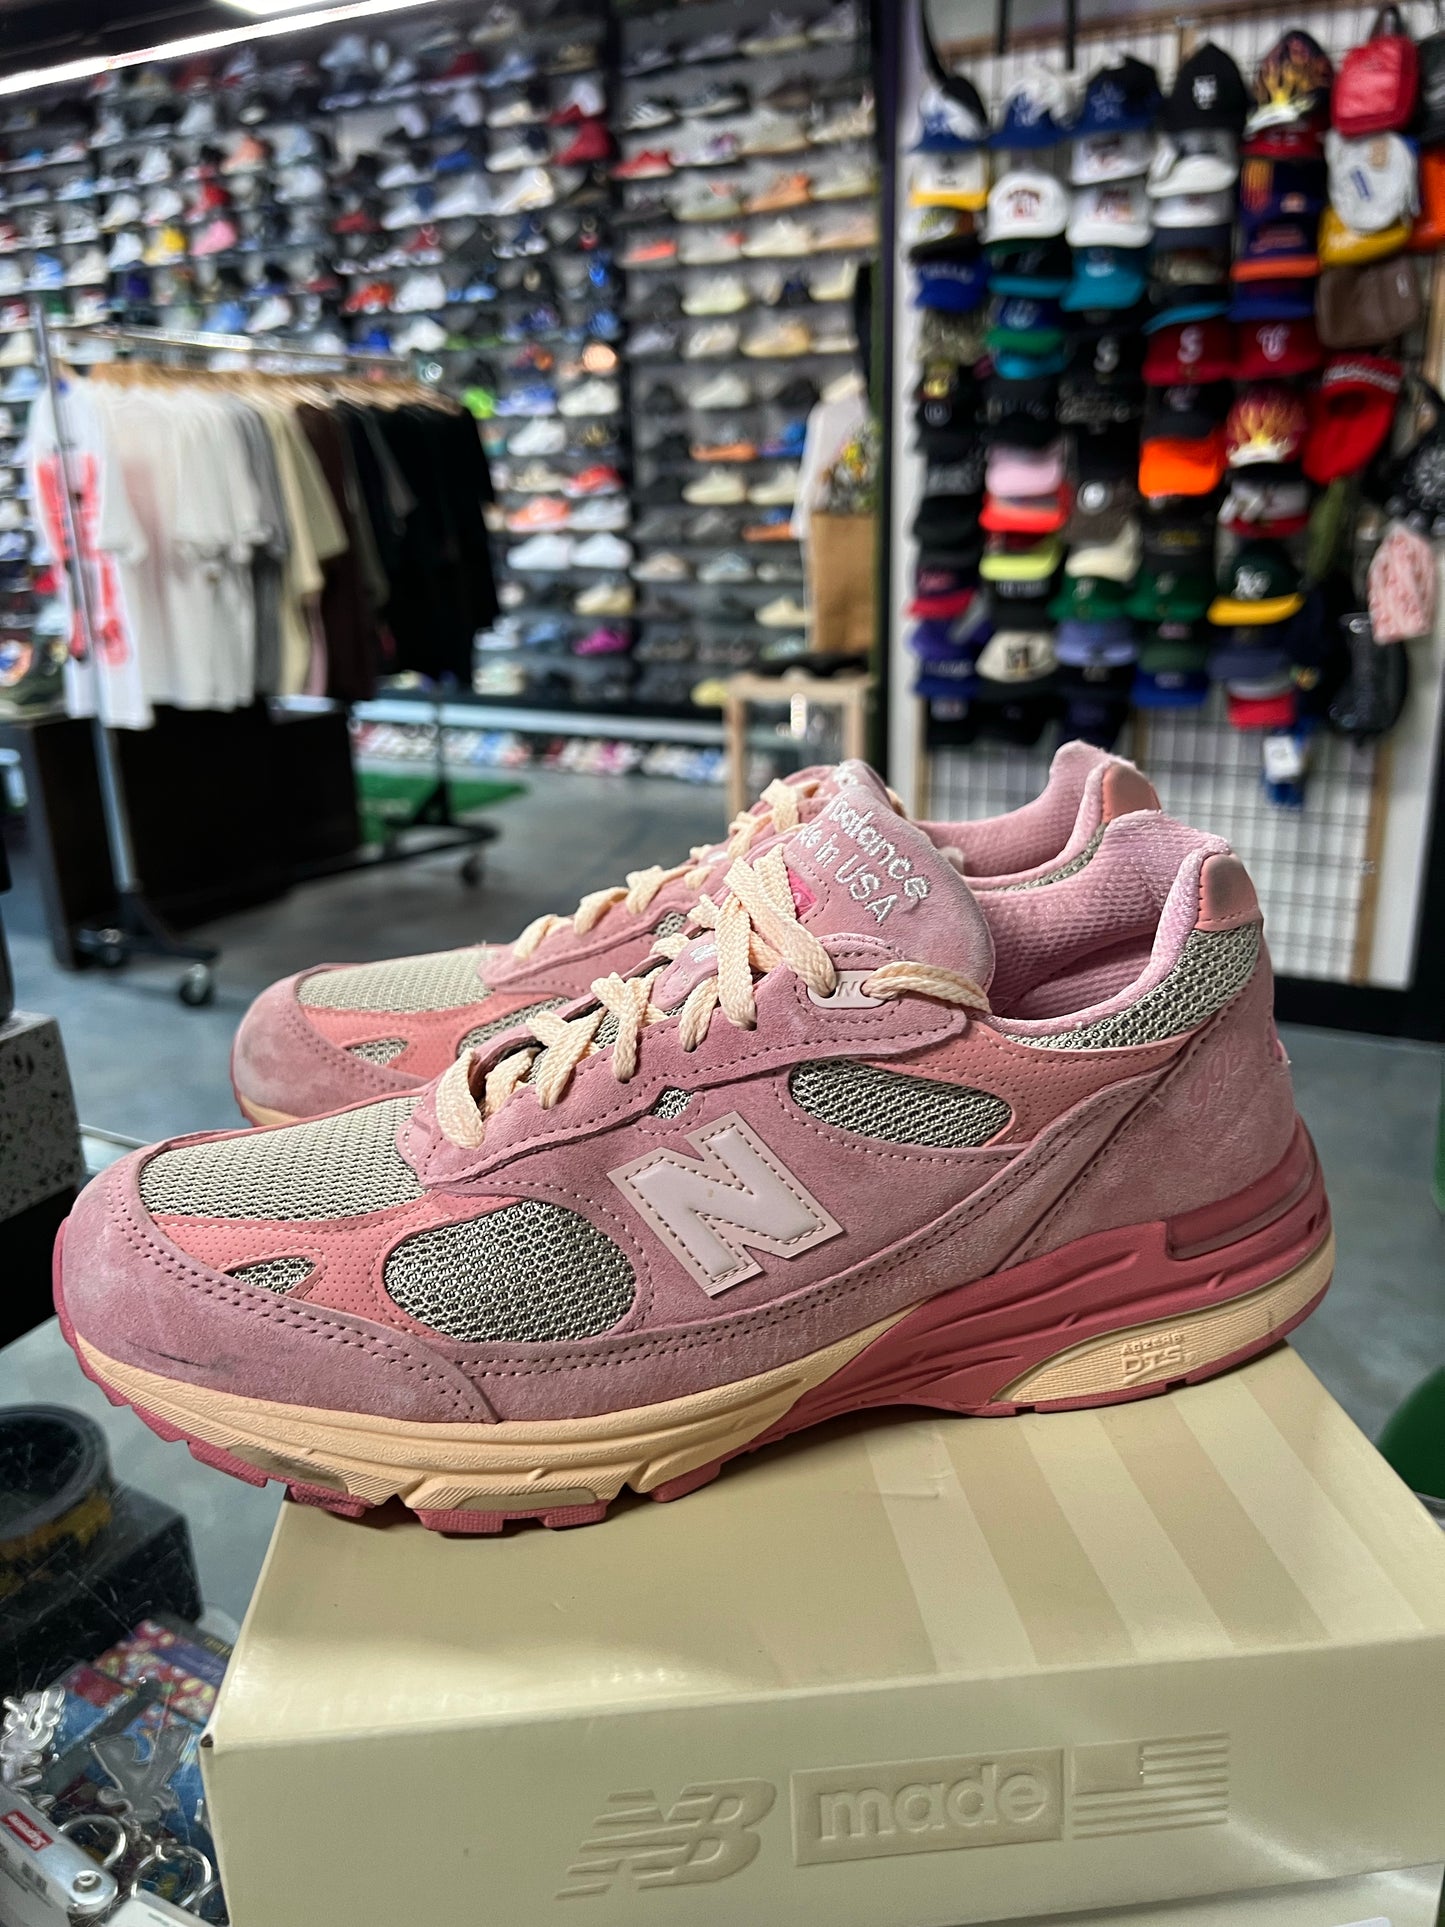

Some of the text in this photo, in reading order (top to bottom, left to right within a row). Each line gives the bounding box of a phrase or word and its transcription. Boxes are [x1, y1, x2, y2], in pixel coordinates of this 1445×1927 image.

[813, 832, 840, 869] in
[834, 854, 898, 924] USA
[829, 792, 931, 900] balance
[606, 1110, 845, 1299] N
[815, 1762, 1049, 1841] made
